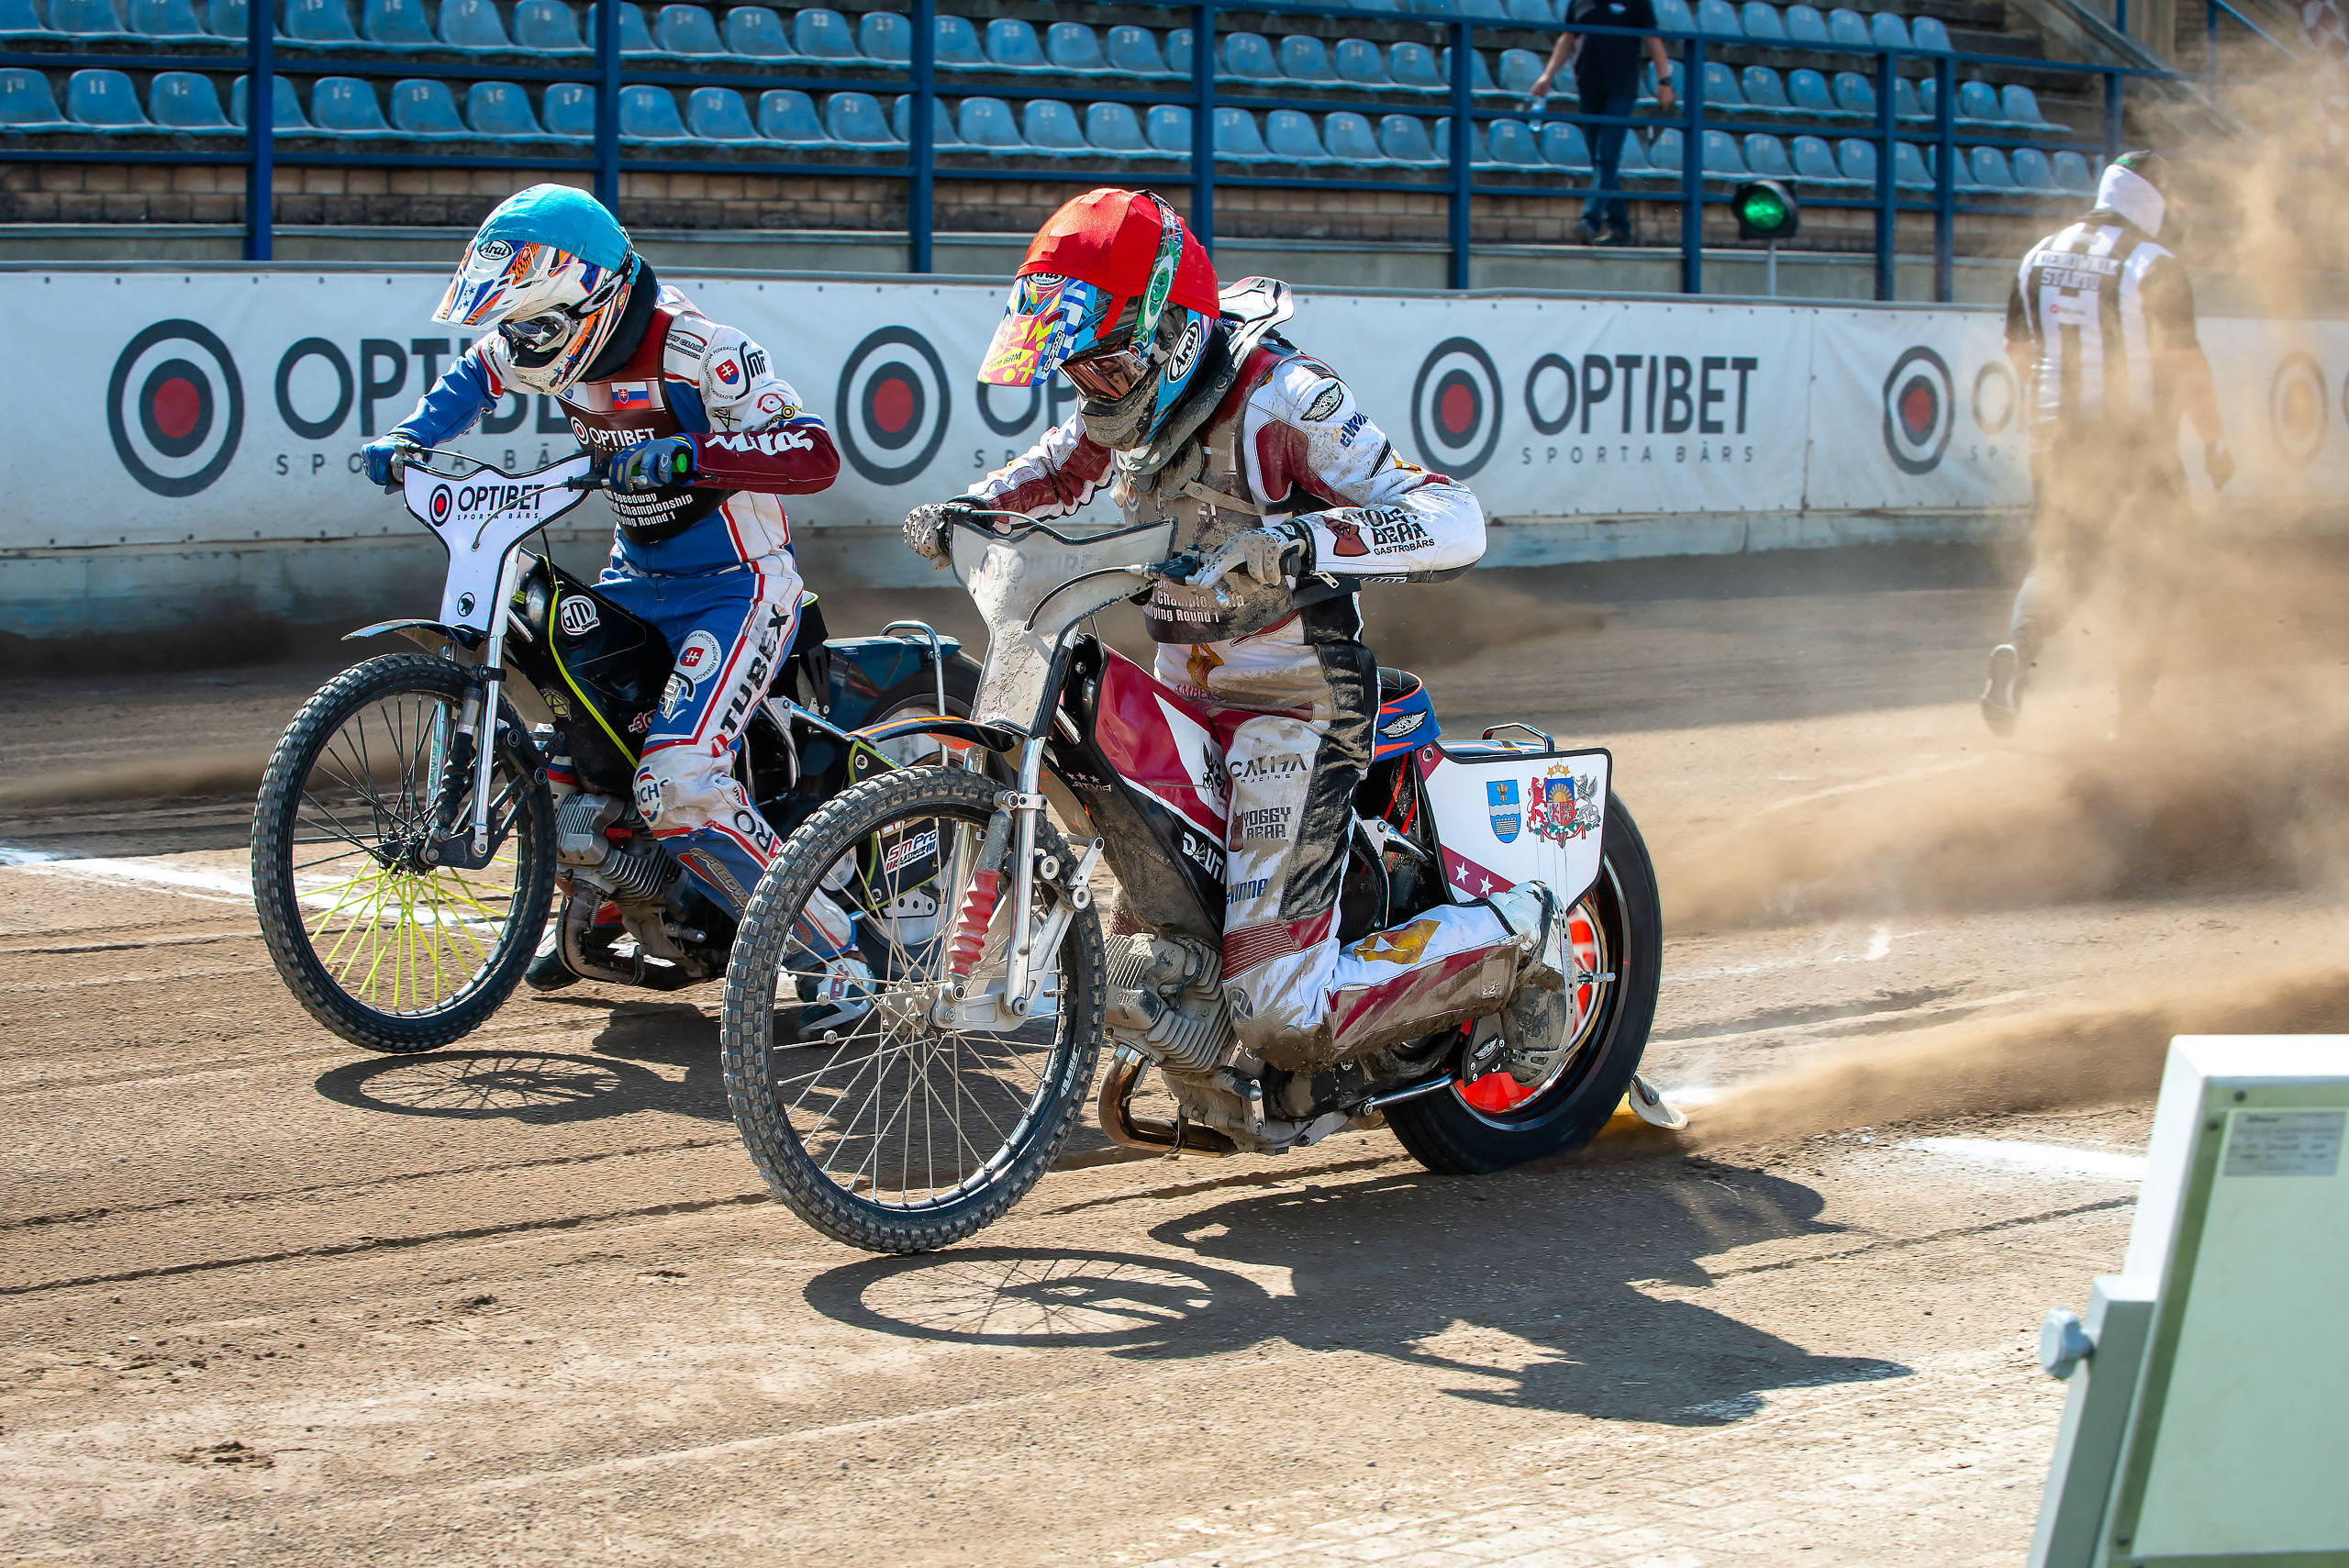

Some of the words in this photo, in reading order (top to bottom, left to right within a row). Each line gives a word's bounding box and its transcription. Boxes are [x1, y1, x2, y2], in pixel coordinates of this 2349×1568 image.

[562, 88, 583, 106] 17
[480, 241, 508, 256] Arai
[1173, 327, 1198, 379] Arai
[1524, 352, 1758, 436] OPTIBET
[1522, 446, 1652, 465] SPORTA
[458, 484, 545, 512] OPTIBET
[613, 492, 658, 504] Speedway
[619, 494, 694, 516] Championship
[457, 513, 499, 521] SPORTA
[637, 512, 669, 527] Round
[669, 510, 676, 520] 1
[1175, 608, 1211, 623] Round
[719, 603, 791, 735] TUBEX
[1240, 773, 1292, 784] RACING
[1243, 806, 1292, 828] YOGGY
[689, 847, 752, 908] SPEEDW
